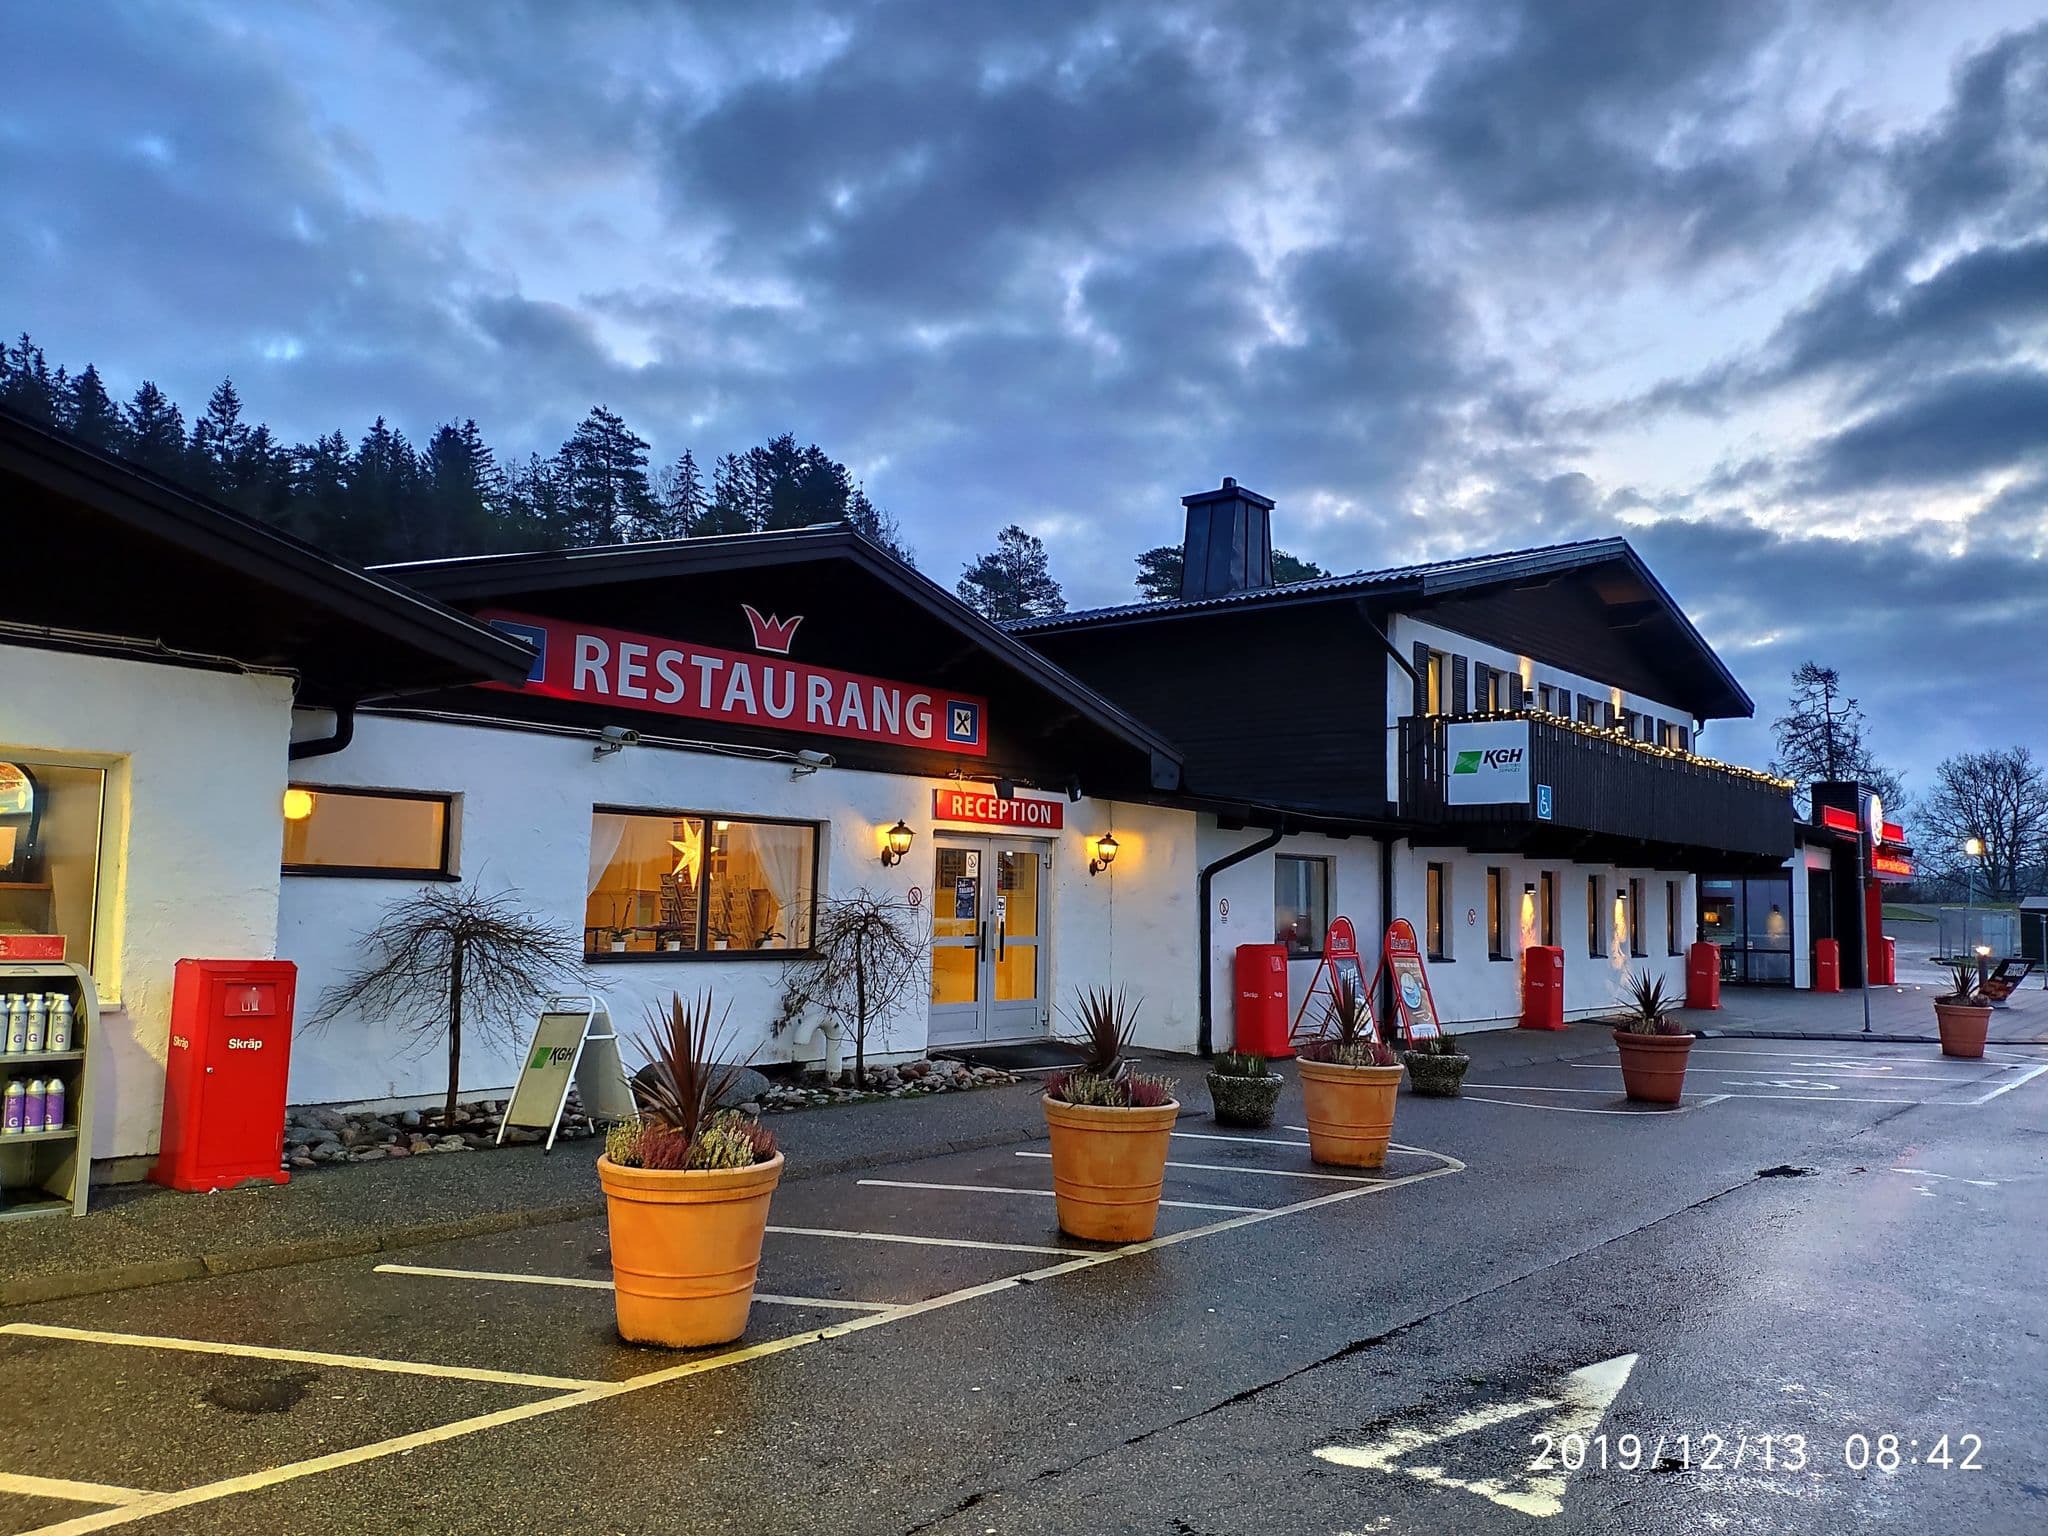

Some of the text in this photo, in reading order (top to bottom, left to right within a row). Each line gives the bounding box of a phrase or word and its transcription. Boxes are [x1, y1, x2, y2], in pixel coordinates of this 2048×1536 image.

[573, 633, 932, 738] RESTAURANG
[1483, 748, 1523, 769] KGH
[951, 795, 1051, 824] RECEPTION
[173, 1035, 189, 1050] Skräp
[228, 1038, 262, 1050] Skräp
[549, 1047, 576, 1065] KGH
[9, 1117, 18, 1127] G
